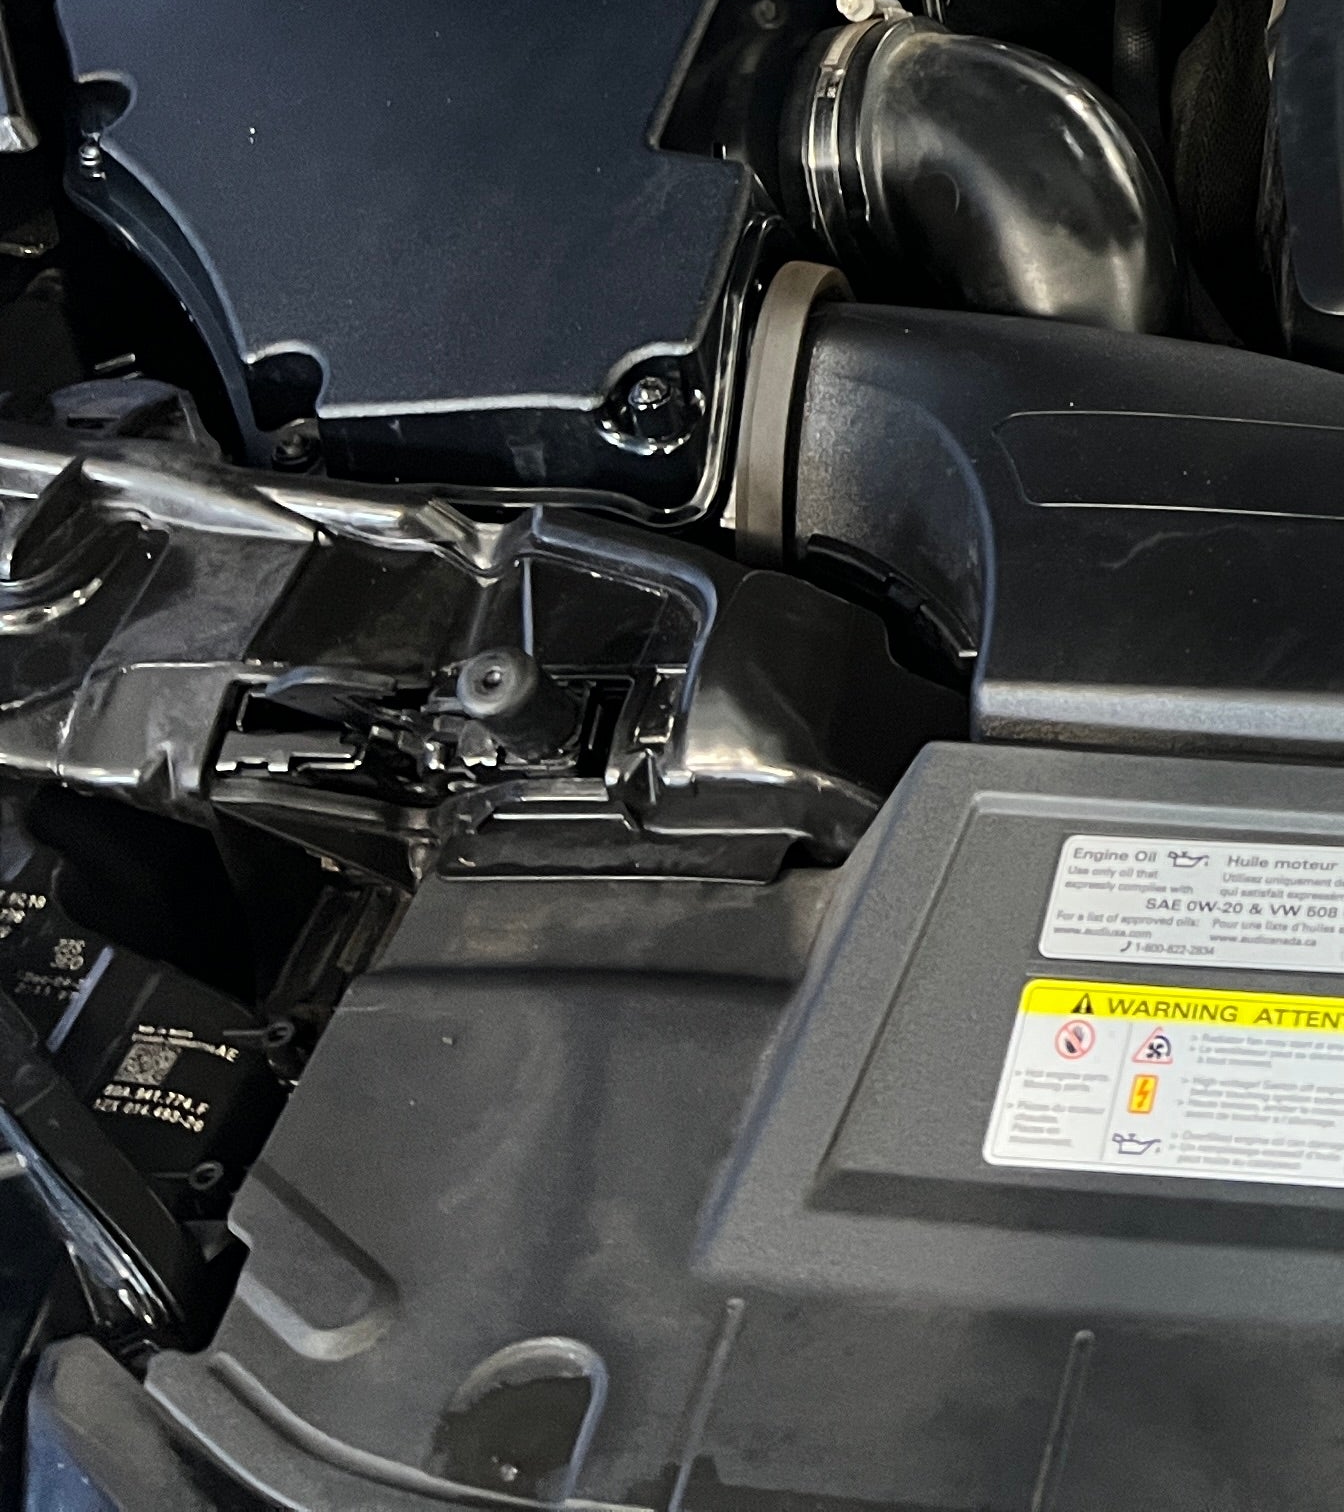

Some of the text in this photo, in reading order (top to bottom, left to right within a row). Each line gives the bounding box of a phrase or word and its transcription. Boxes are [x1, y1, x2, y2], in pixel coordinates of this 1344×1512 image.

[1073, 847, 1157, 862] Engine Oil
[1227, 855, 1339, 871] Huile moteur
[1119, 868, 1134, 877] oil
[1137, 869, 1158, 879] that
[1219, 888, 1238, 899] qui
[1145, 898, 1182, 911] SAE
[1187, 900, 1243, 914] 0W-20
[1249, 903, 1263, 915] &
[1270, 904, 1301, 917] VW
[1306, 906, 1338, 918] 508
[1106, 913, 1119, 923] of
[1212, 919, 1239, 929] Pour
[1107, 997, 1239, 1023] WARNING
